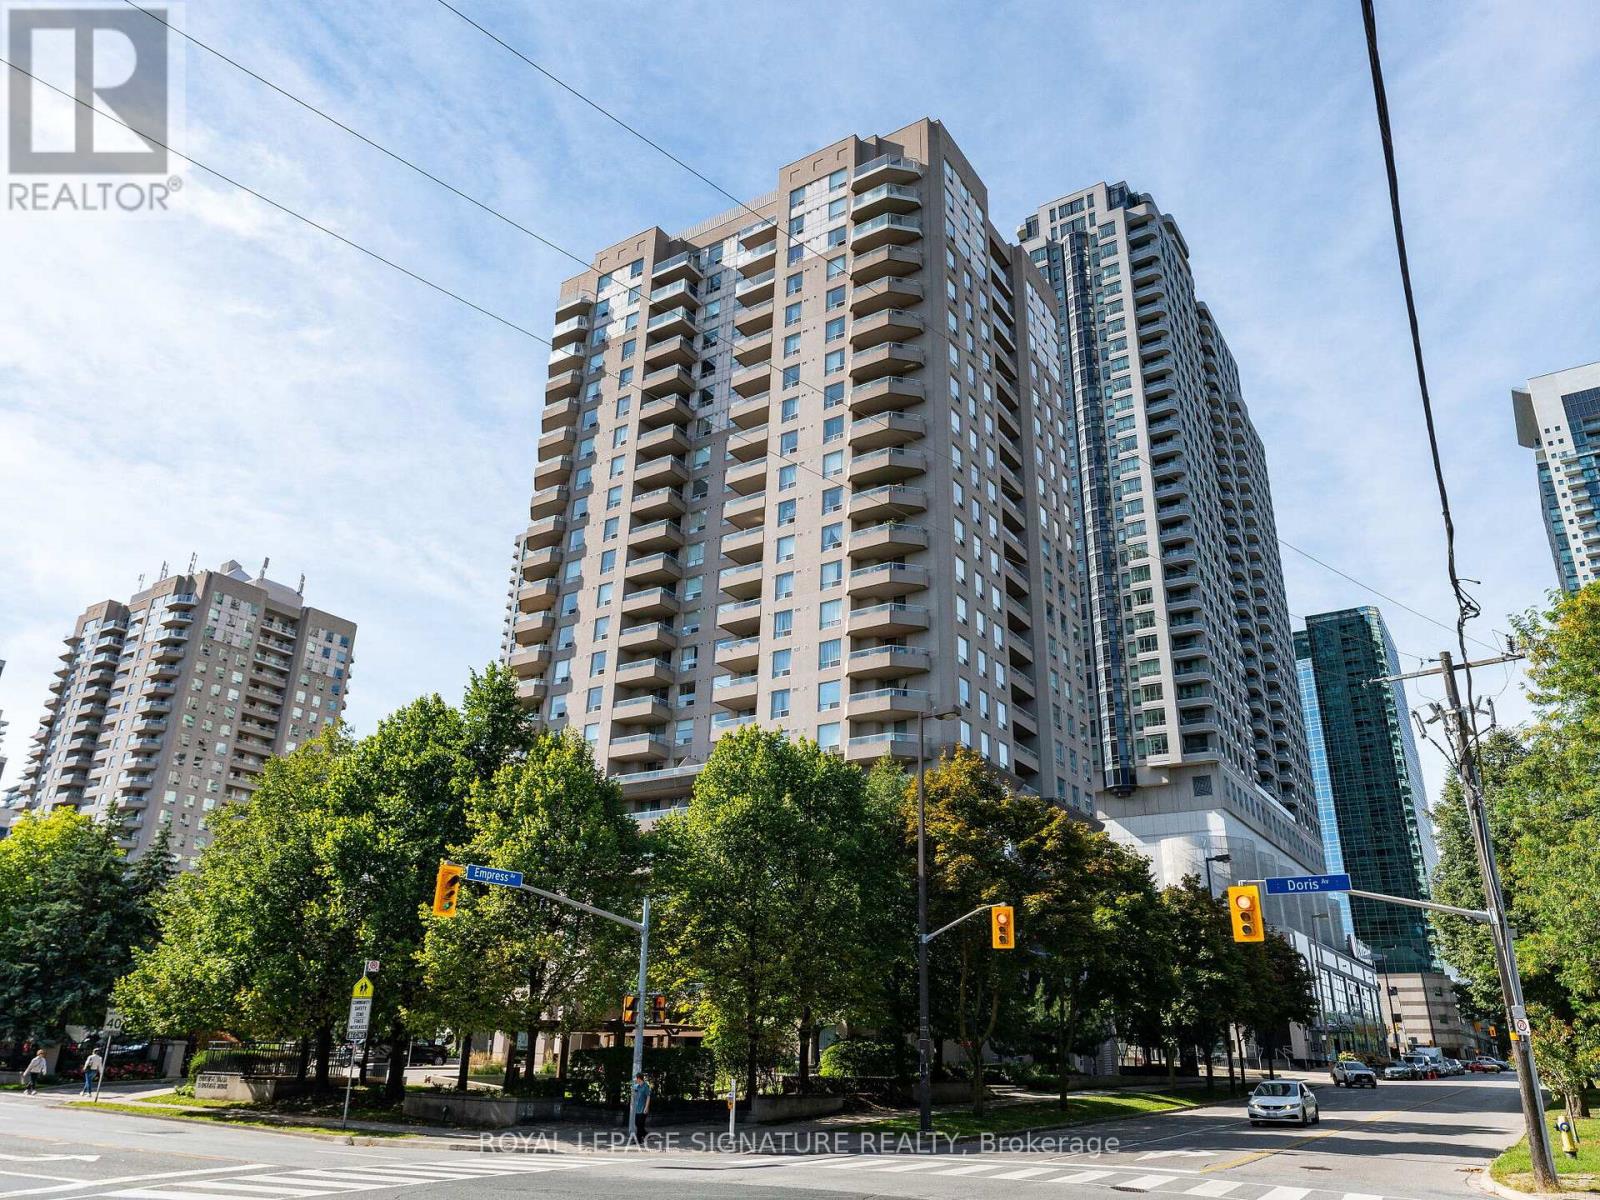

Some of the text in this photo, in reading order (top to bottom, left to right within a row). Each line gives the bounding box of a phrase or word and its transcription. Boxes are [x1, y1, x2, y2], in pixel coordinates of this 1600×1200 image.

[474, 867, 509, 882] Empress
[1287, 879, 1319, 891] Doris
[107, 1018, 121, 1029] 40
